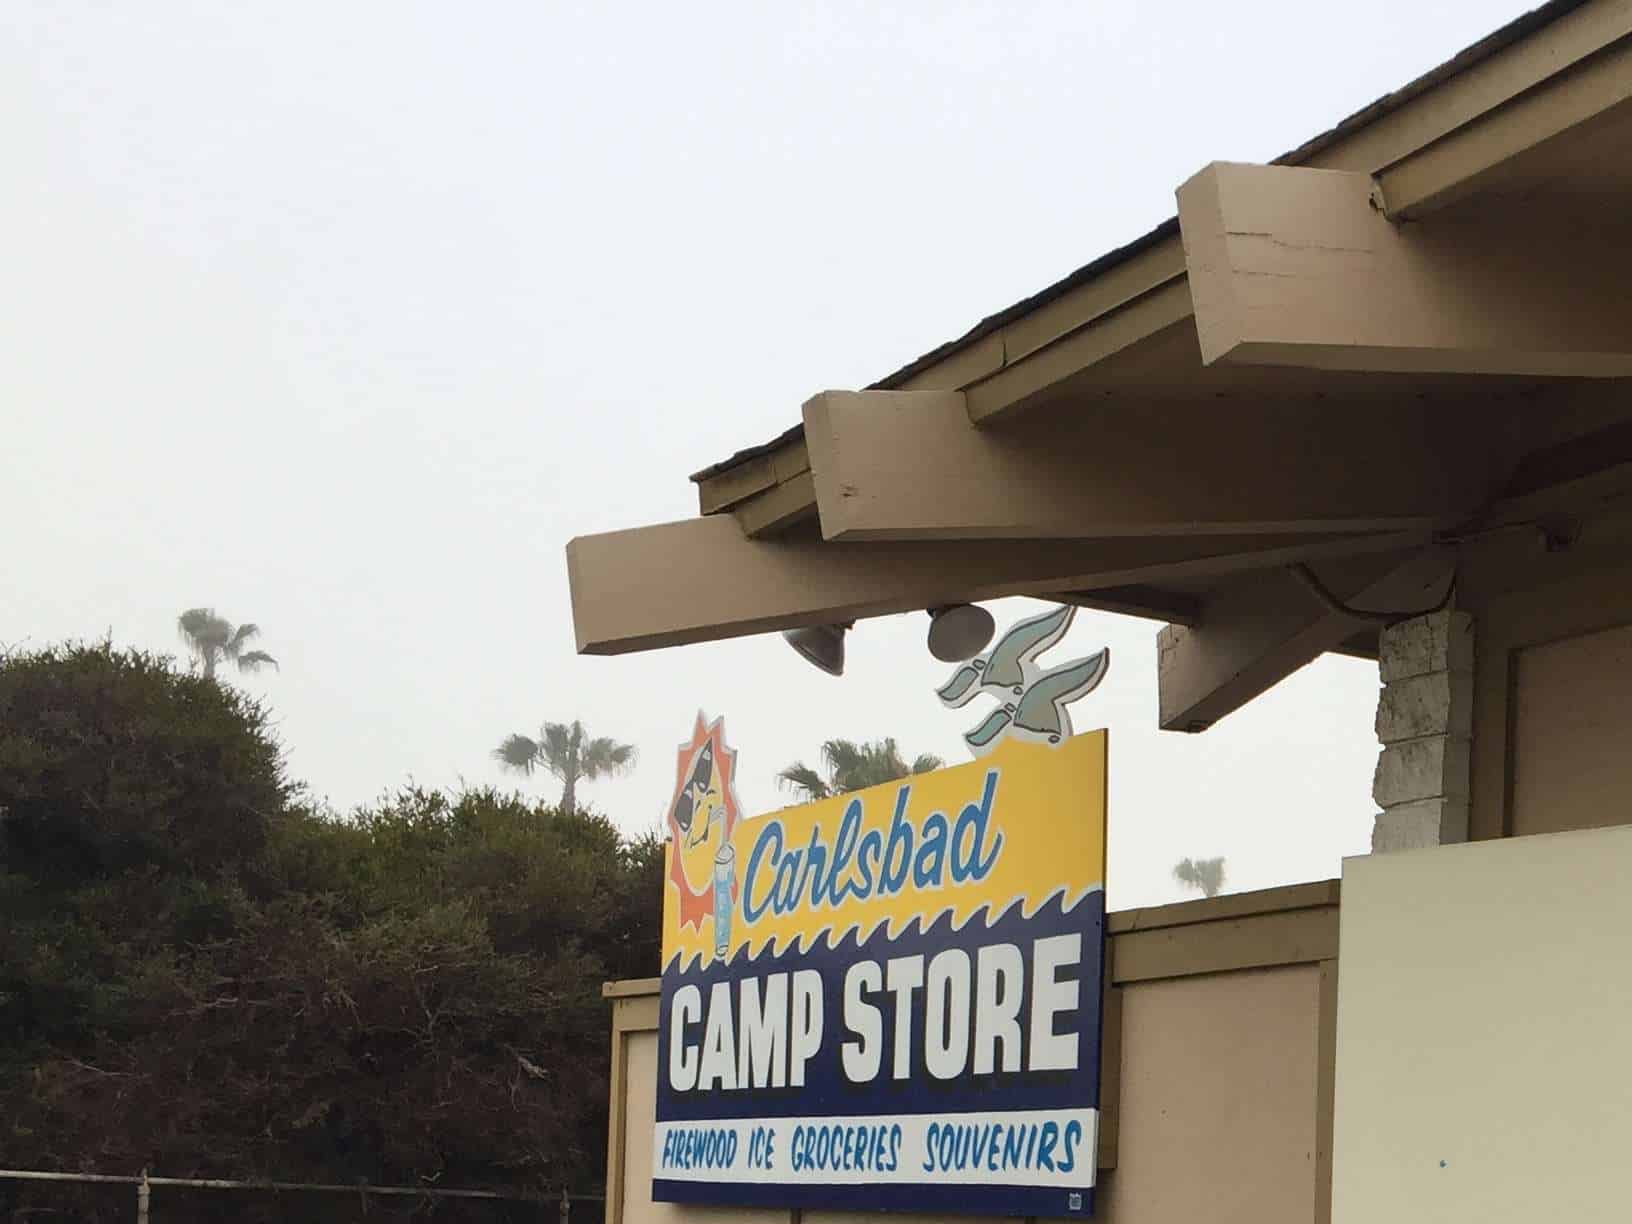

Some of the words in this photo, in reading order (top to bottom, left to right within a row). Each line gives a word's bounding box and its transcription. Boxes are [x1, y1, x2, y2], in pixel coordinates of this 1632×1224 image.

[743, 771, 1003, 924] Carlsbad
[669, 968, 825, 1092] CAMP
[841, 932, 1083, 1083] STORE
[662, 1127, 738, 1170] FIREWOOD
[747, 1126, 776, 1169] ICE
[791, 1124, 902, 1172] GROCERIES
[923, 1119, 1083, 1172] SOUVENIRS
